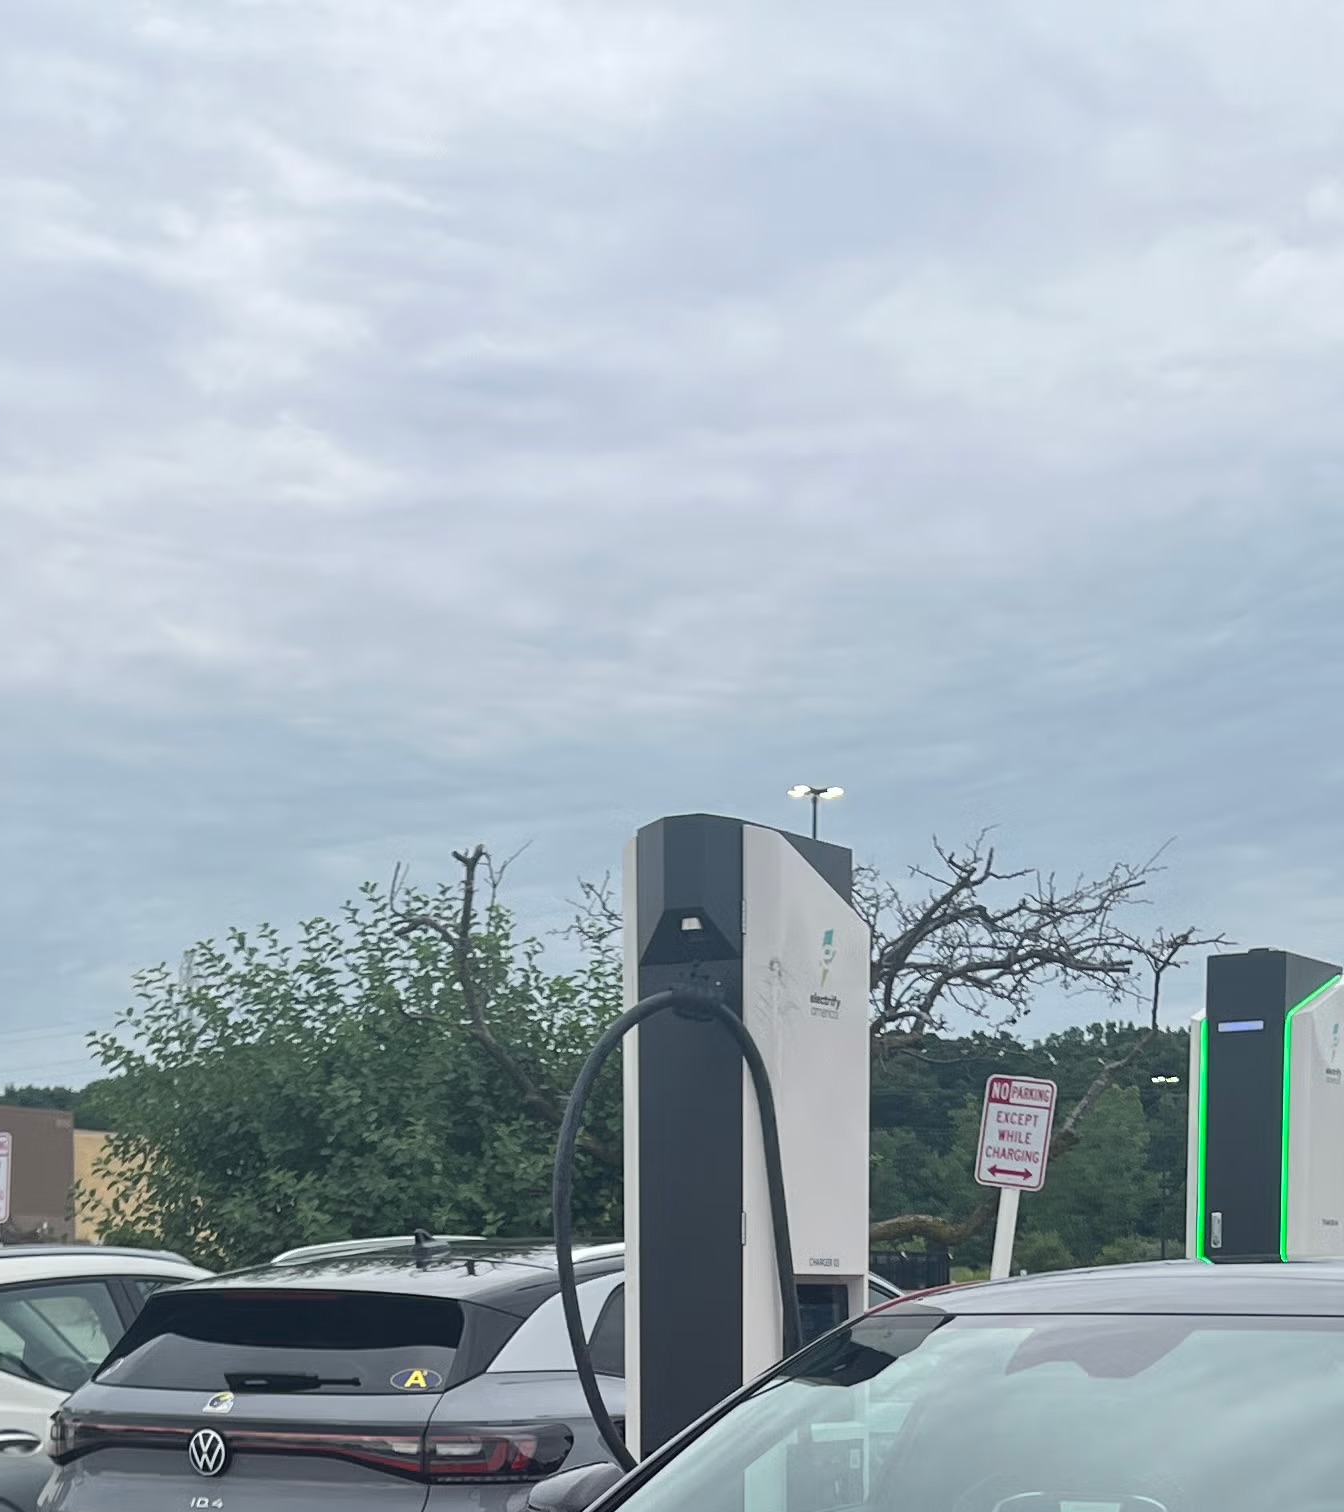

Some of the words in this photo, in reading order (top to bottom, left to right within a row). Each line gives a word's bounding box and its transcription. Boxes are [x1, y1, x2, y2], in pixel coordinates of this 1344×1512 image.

[991, 1081, 1010, 1100] NO
[1011, 1085, 1051, 1103] PARKING
[996, 1110, 1039, 1128] EXCEPT
[997, 1129, 1033, 1145] WHILE
[985, 1146, 1040, 1164] CHARGING
